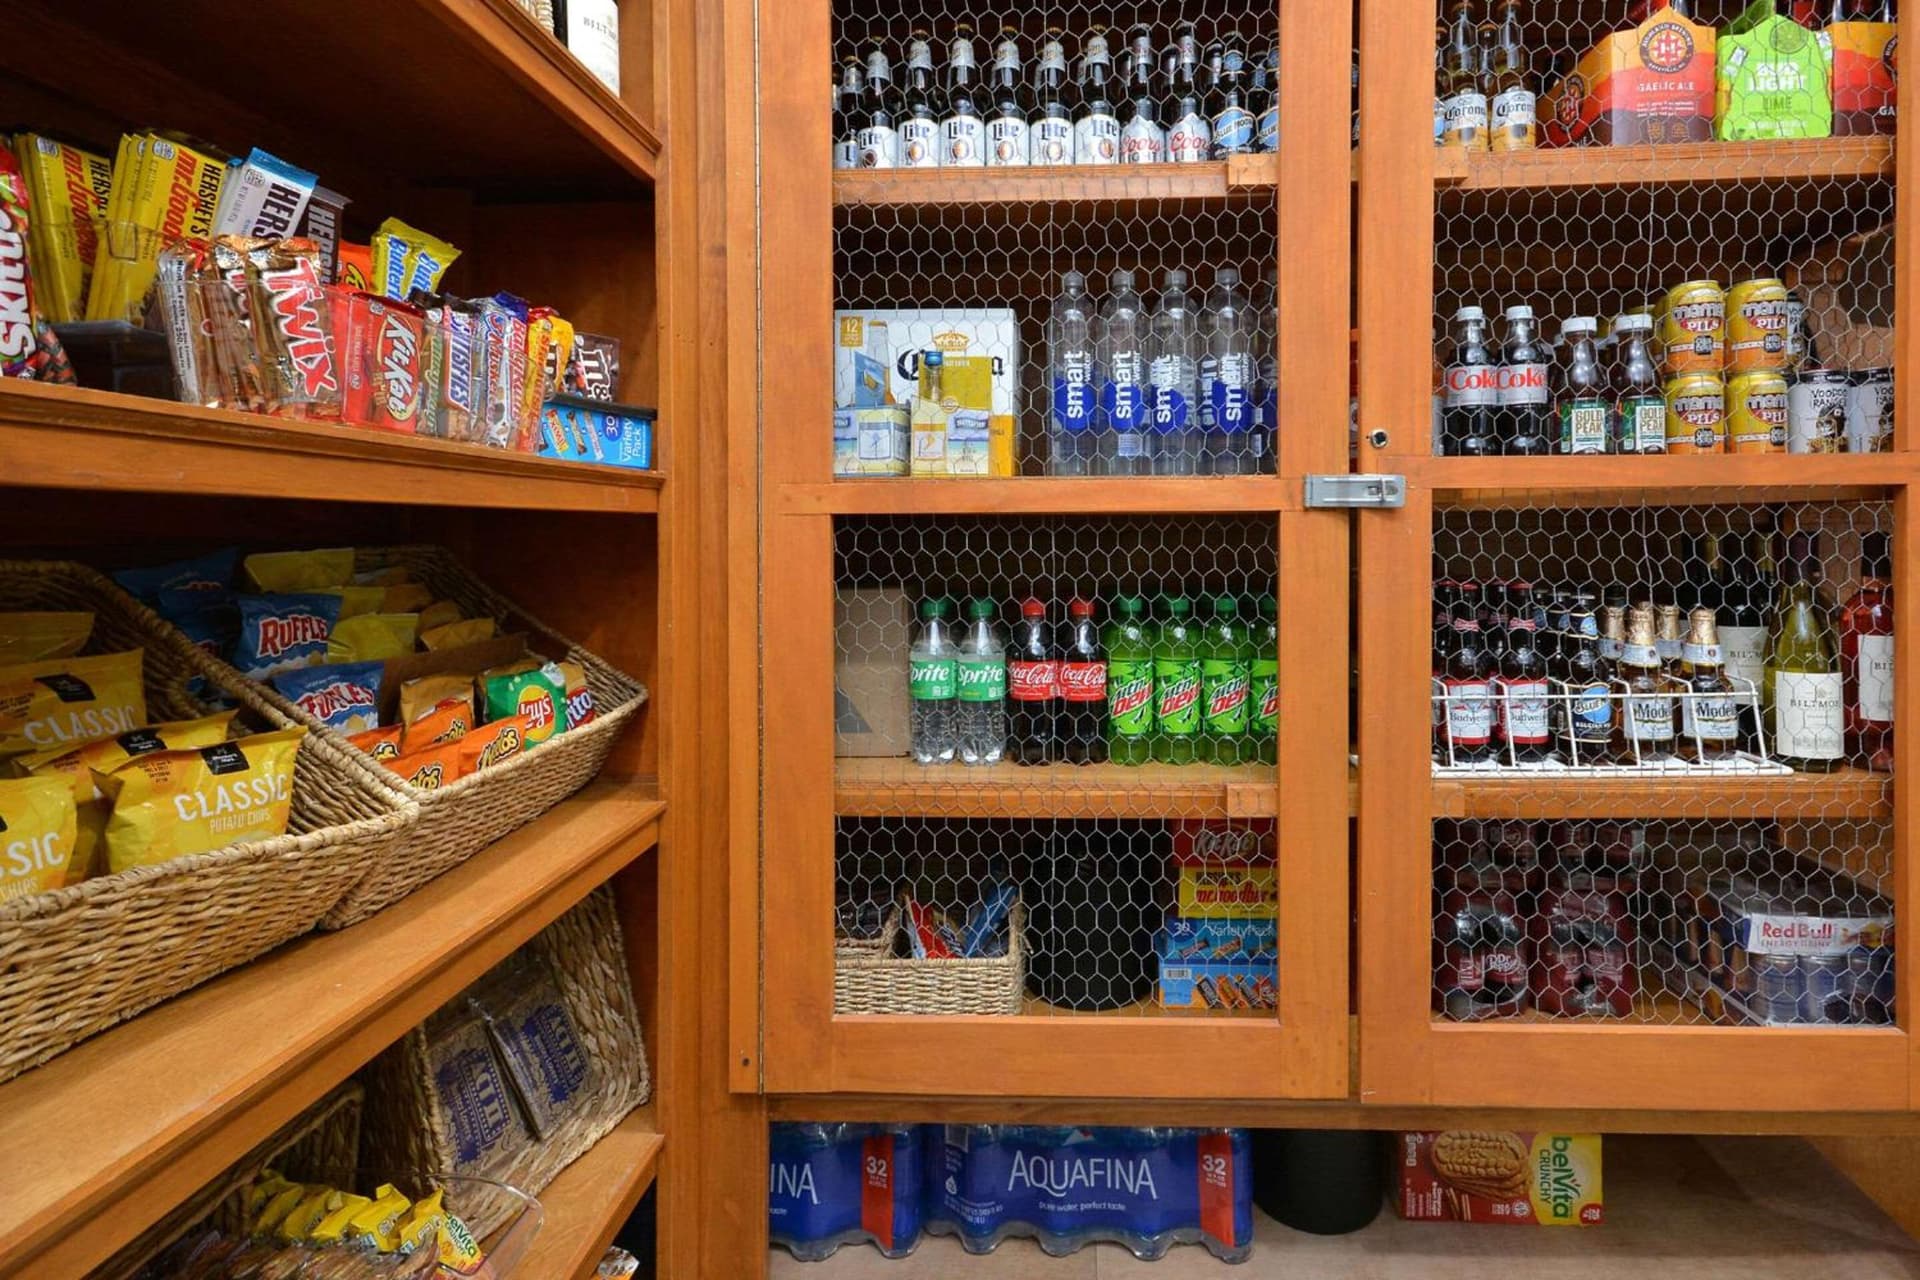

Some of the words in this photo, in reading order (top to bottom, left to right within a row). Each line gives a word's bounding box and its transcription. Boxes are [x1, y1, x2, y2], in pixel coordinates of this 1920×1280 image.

[1638, 82, 1674, 91] GAELIC
[1677, 82, 1694, 90] ALE
[903, 124, 930, 142] Lite
[948, 122, 975, 139] Lite
[993, 123, 1019, 141] Lite
[1041, 123, 1067, 140] Lite
[262, 257, 337, 397] TWIX
[845, 318, 858, 333] 12
[1064, 351, 1083, 418] smart
[1112, 350, 1132, 418] smart
[620, 418, 634, 463] Variety
[631, 427, 642, 458] Pack
[958, 664, 1003, 686] Sprite
[173, 773, 288, 821] CLASSIC
[1762, 922, 1795, 938] Red
[1798, 923, 1832, 938] Bull
[867, 1156, 888, 1177] 32
[1008, 1150, 1157, 1200] AQUAFINA
[1202, 1154, 1226, 1176] 32
[1539, 1149, 1551, 1204] CRUNCHY
[1552, 1136, 1580, 1218] belVita
[1080, 1201, 1106, 1211] perfect
